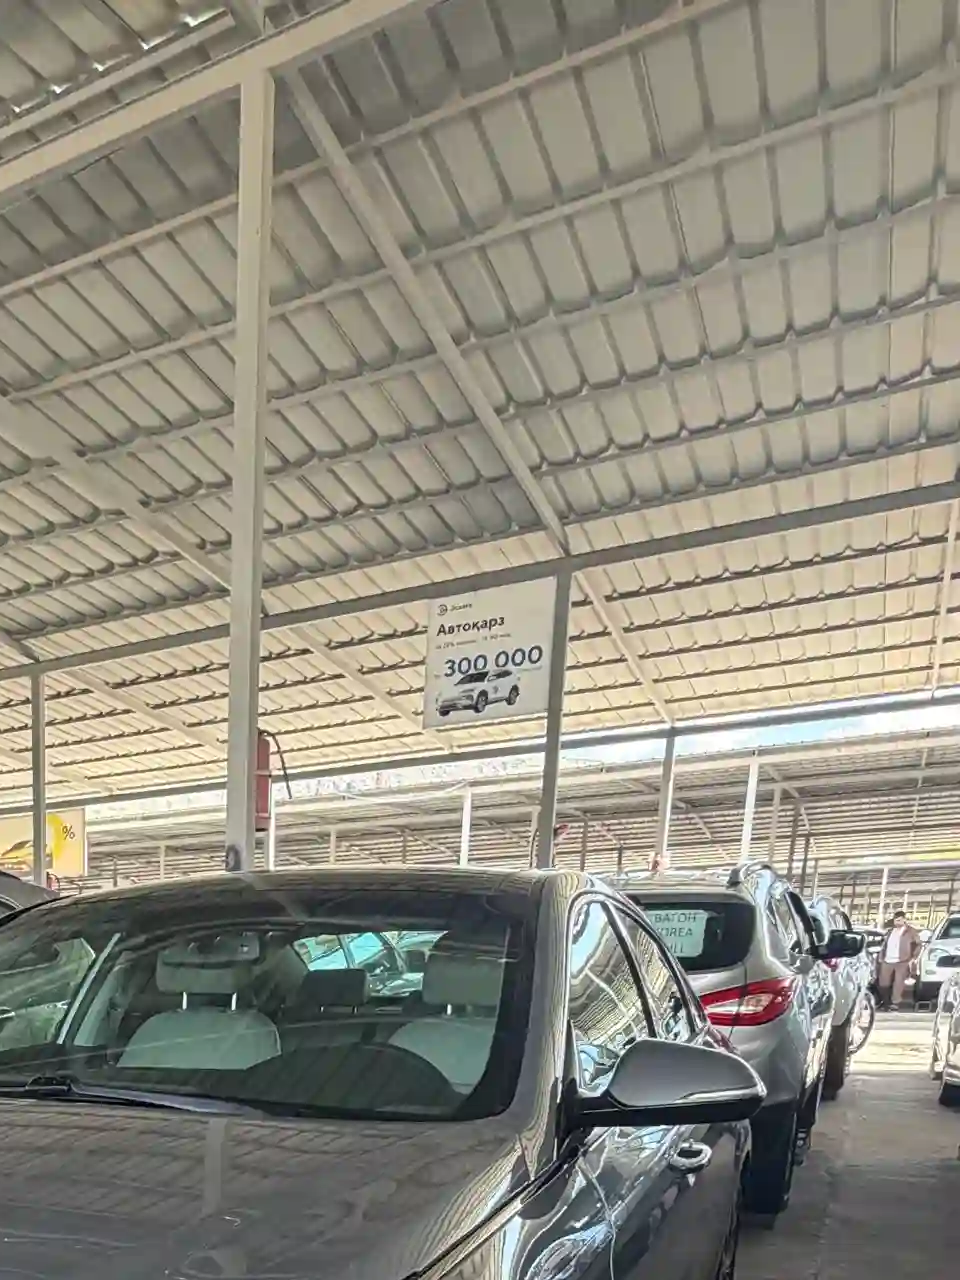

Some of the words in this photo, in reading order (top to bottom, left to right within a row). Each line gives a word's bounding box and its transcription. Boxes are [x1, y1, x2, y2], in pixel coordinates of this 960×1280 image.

[436, 616, 505, 637] Автоқарз
[444, 654, 488, 678] 300
[495, 645, 544, 668] 000
